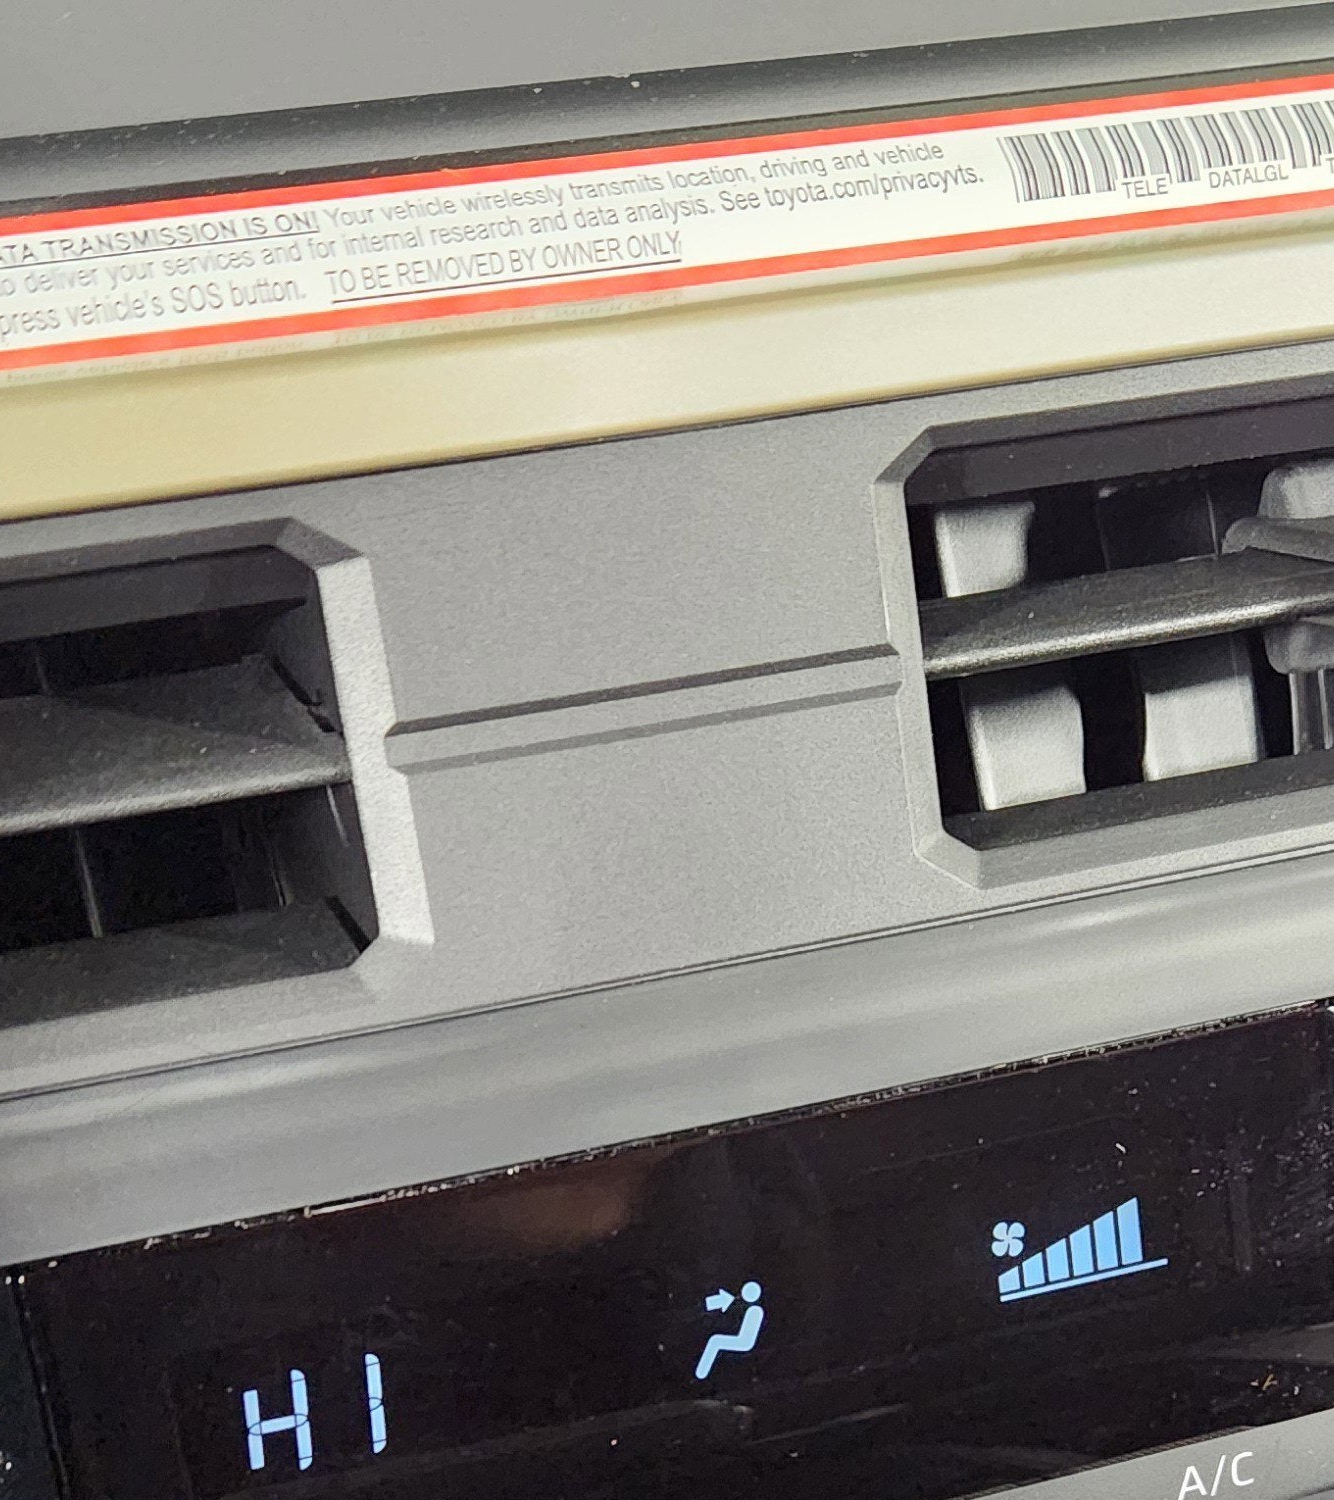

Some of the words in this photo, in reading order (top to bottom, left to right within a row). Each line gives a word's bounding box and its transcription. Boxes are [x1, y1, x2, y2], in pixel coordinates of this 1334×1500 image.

[23, 264, 97, 294] deliver
[106, 259, 155, 291] your
[162, 248, 256, 278] services
[263, 240, 303, 266] and
[307, 236, 337, 261] for
[341, 226, 425, 257] internal
[430, 214, 524, 246] research
[529, 209, 569, 235] and
[573, 205, 620, 230] data
[625, 195, 715, 225] analysis.
[718, 189, 762, 212] See
[764, 162, 984, 212] toyota.com/privacyvts.
[41, 217, 238, 258] TRANSMISSION
[243, 216, 268, 235] IS
[323, 207, 375, 229] Your
[380, 197, 457, 221] vehicle
[461, 180, 564, 213] wirelessly
[569, 173, 665, 200] transmits
[668, 164, 756, 189] location,
[760, 154, 828, 181] driving
[832, 148, 870, 171] and
[874, 141, 944, 166] vehicle
[1120, 178, 1169, 200] TELE
[1208, 162, 1290, 190] DATALGL
[65, 288, 165, 328] vehicle's
[169, 280, 225, 315] SOS
[228, 278, 308, 309] button.
[324, 267, 357, 296] TO
[362, 263, 392, 291] BE
[396, 250, 506, 289] REMOVED
[510, 247, 537, 273] BY
[541, 236, 624, 270] OWNER
[625, 229, 681, 260] ONLY
[241, 1352, 389, 1473] HI
